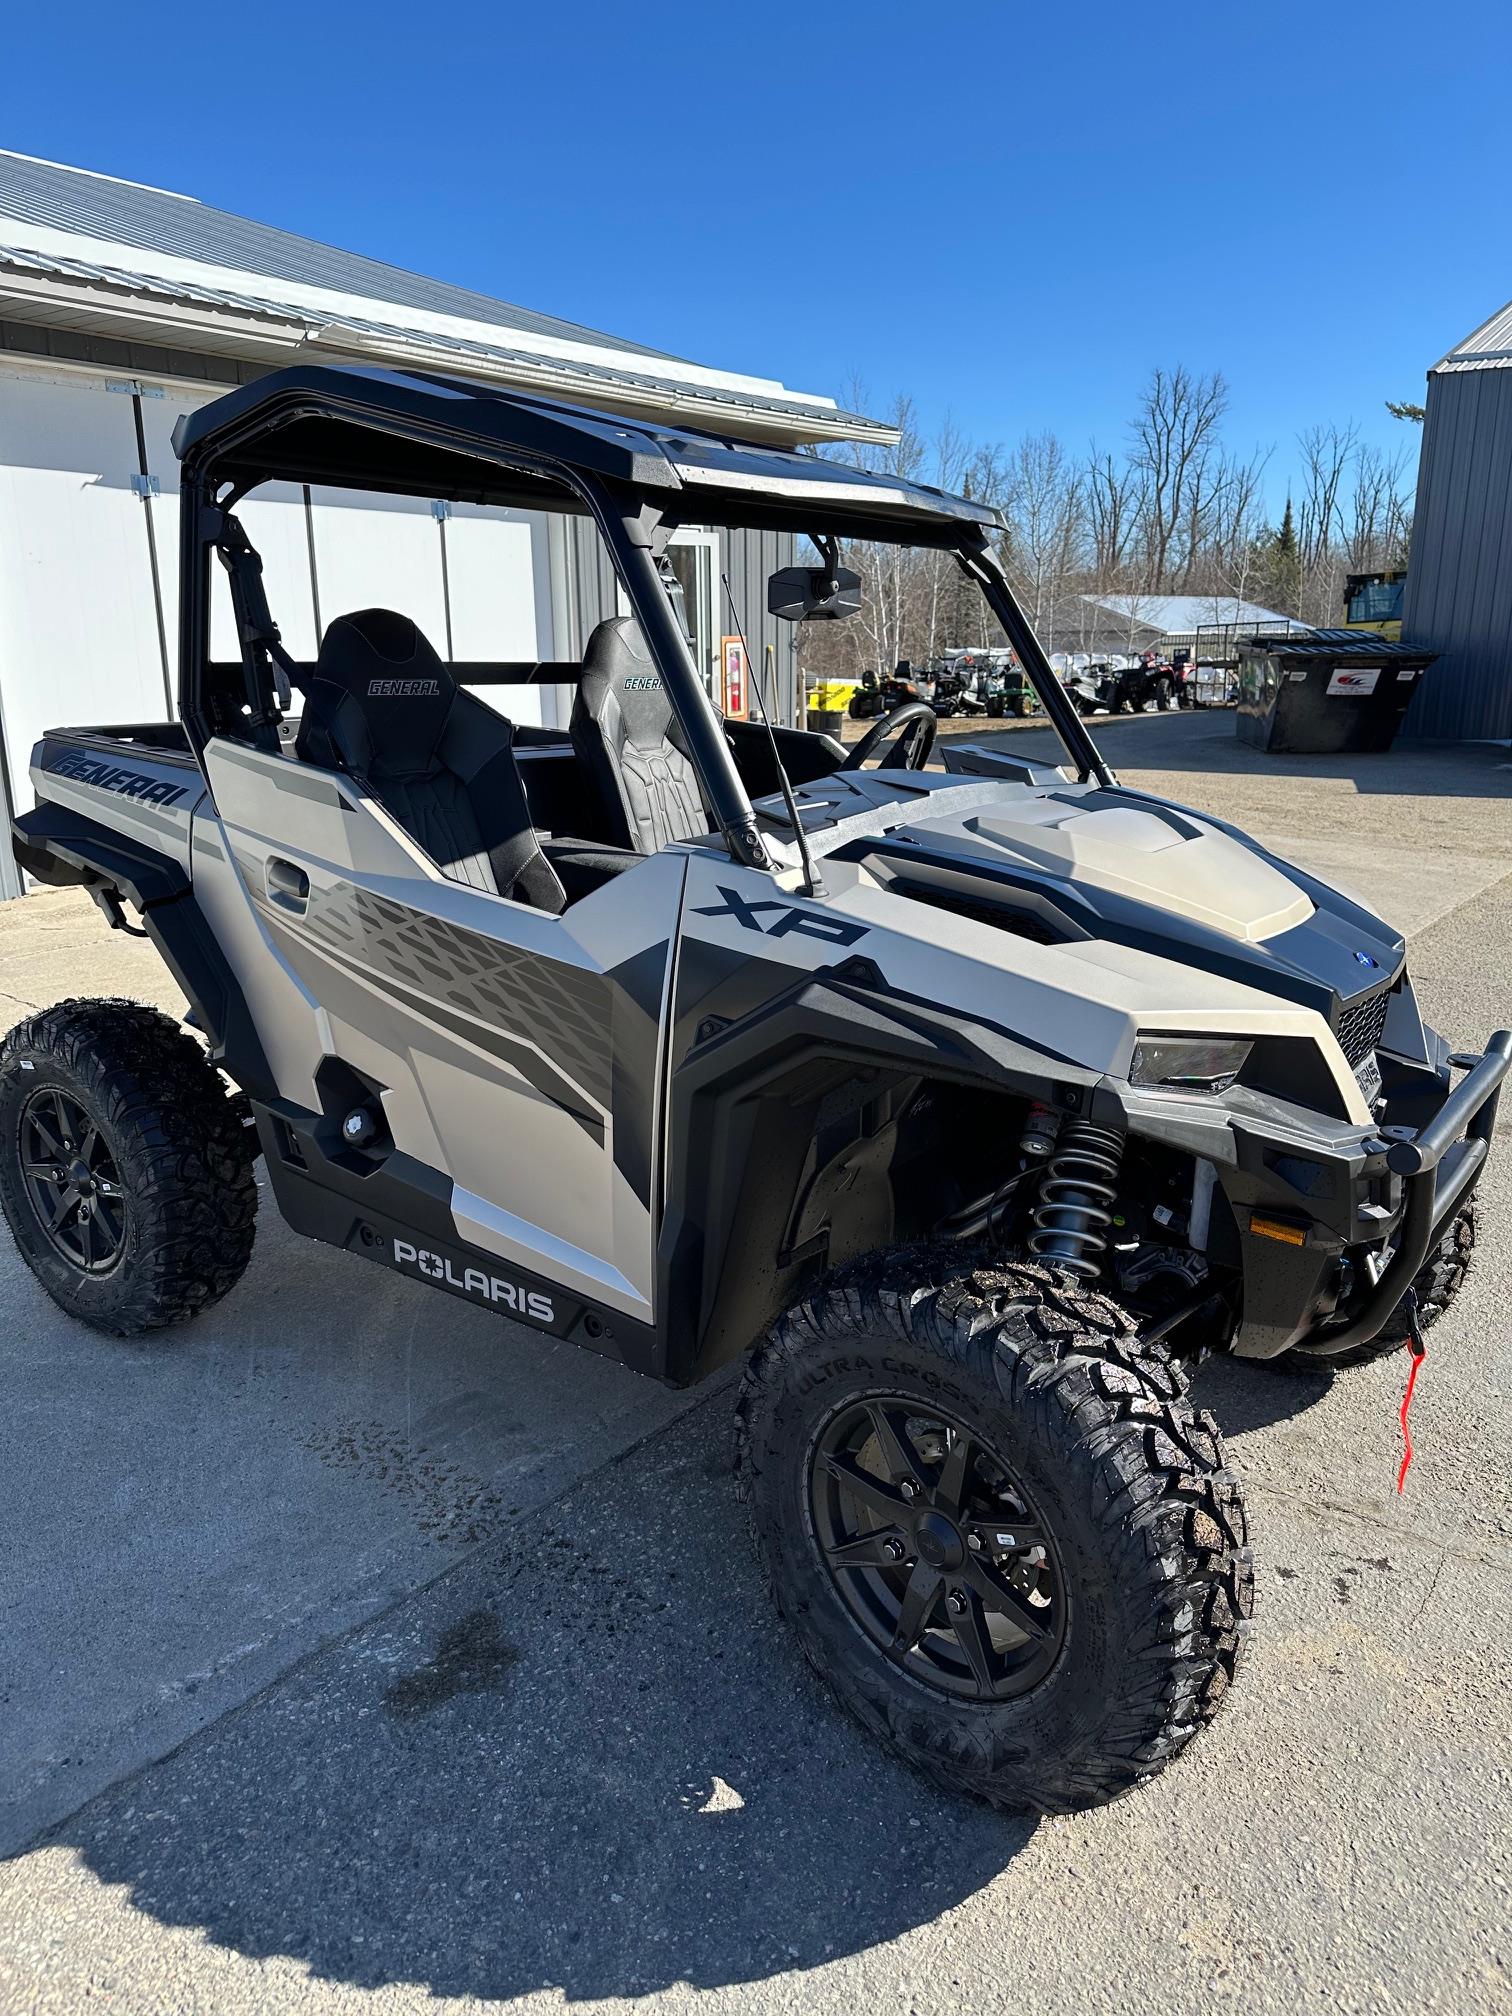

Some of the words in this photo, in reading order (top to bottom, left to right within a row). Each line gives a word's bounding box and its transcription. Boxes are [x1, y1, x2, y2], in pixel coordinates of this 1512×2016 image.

[367, 680, 440, 696] GENERAL
[623, 677, 664, 691] GENER
[46, 753, 191, 818] GENERAL
[688, 884, 872, 947] XP
[393, 1238, 555, 1323] POLARIS
[799, 1355, 875, 1395] ULTRA
